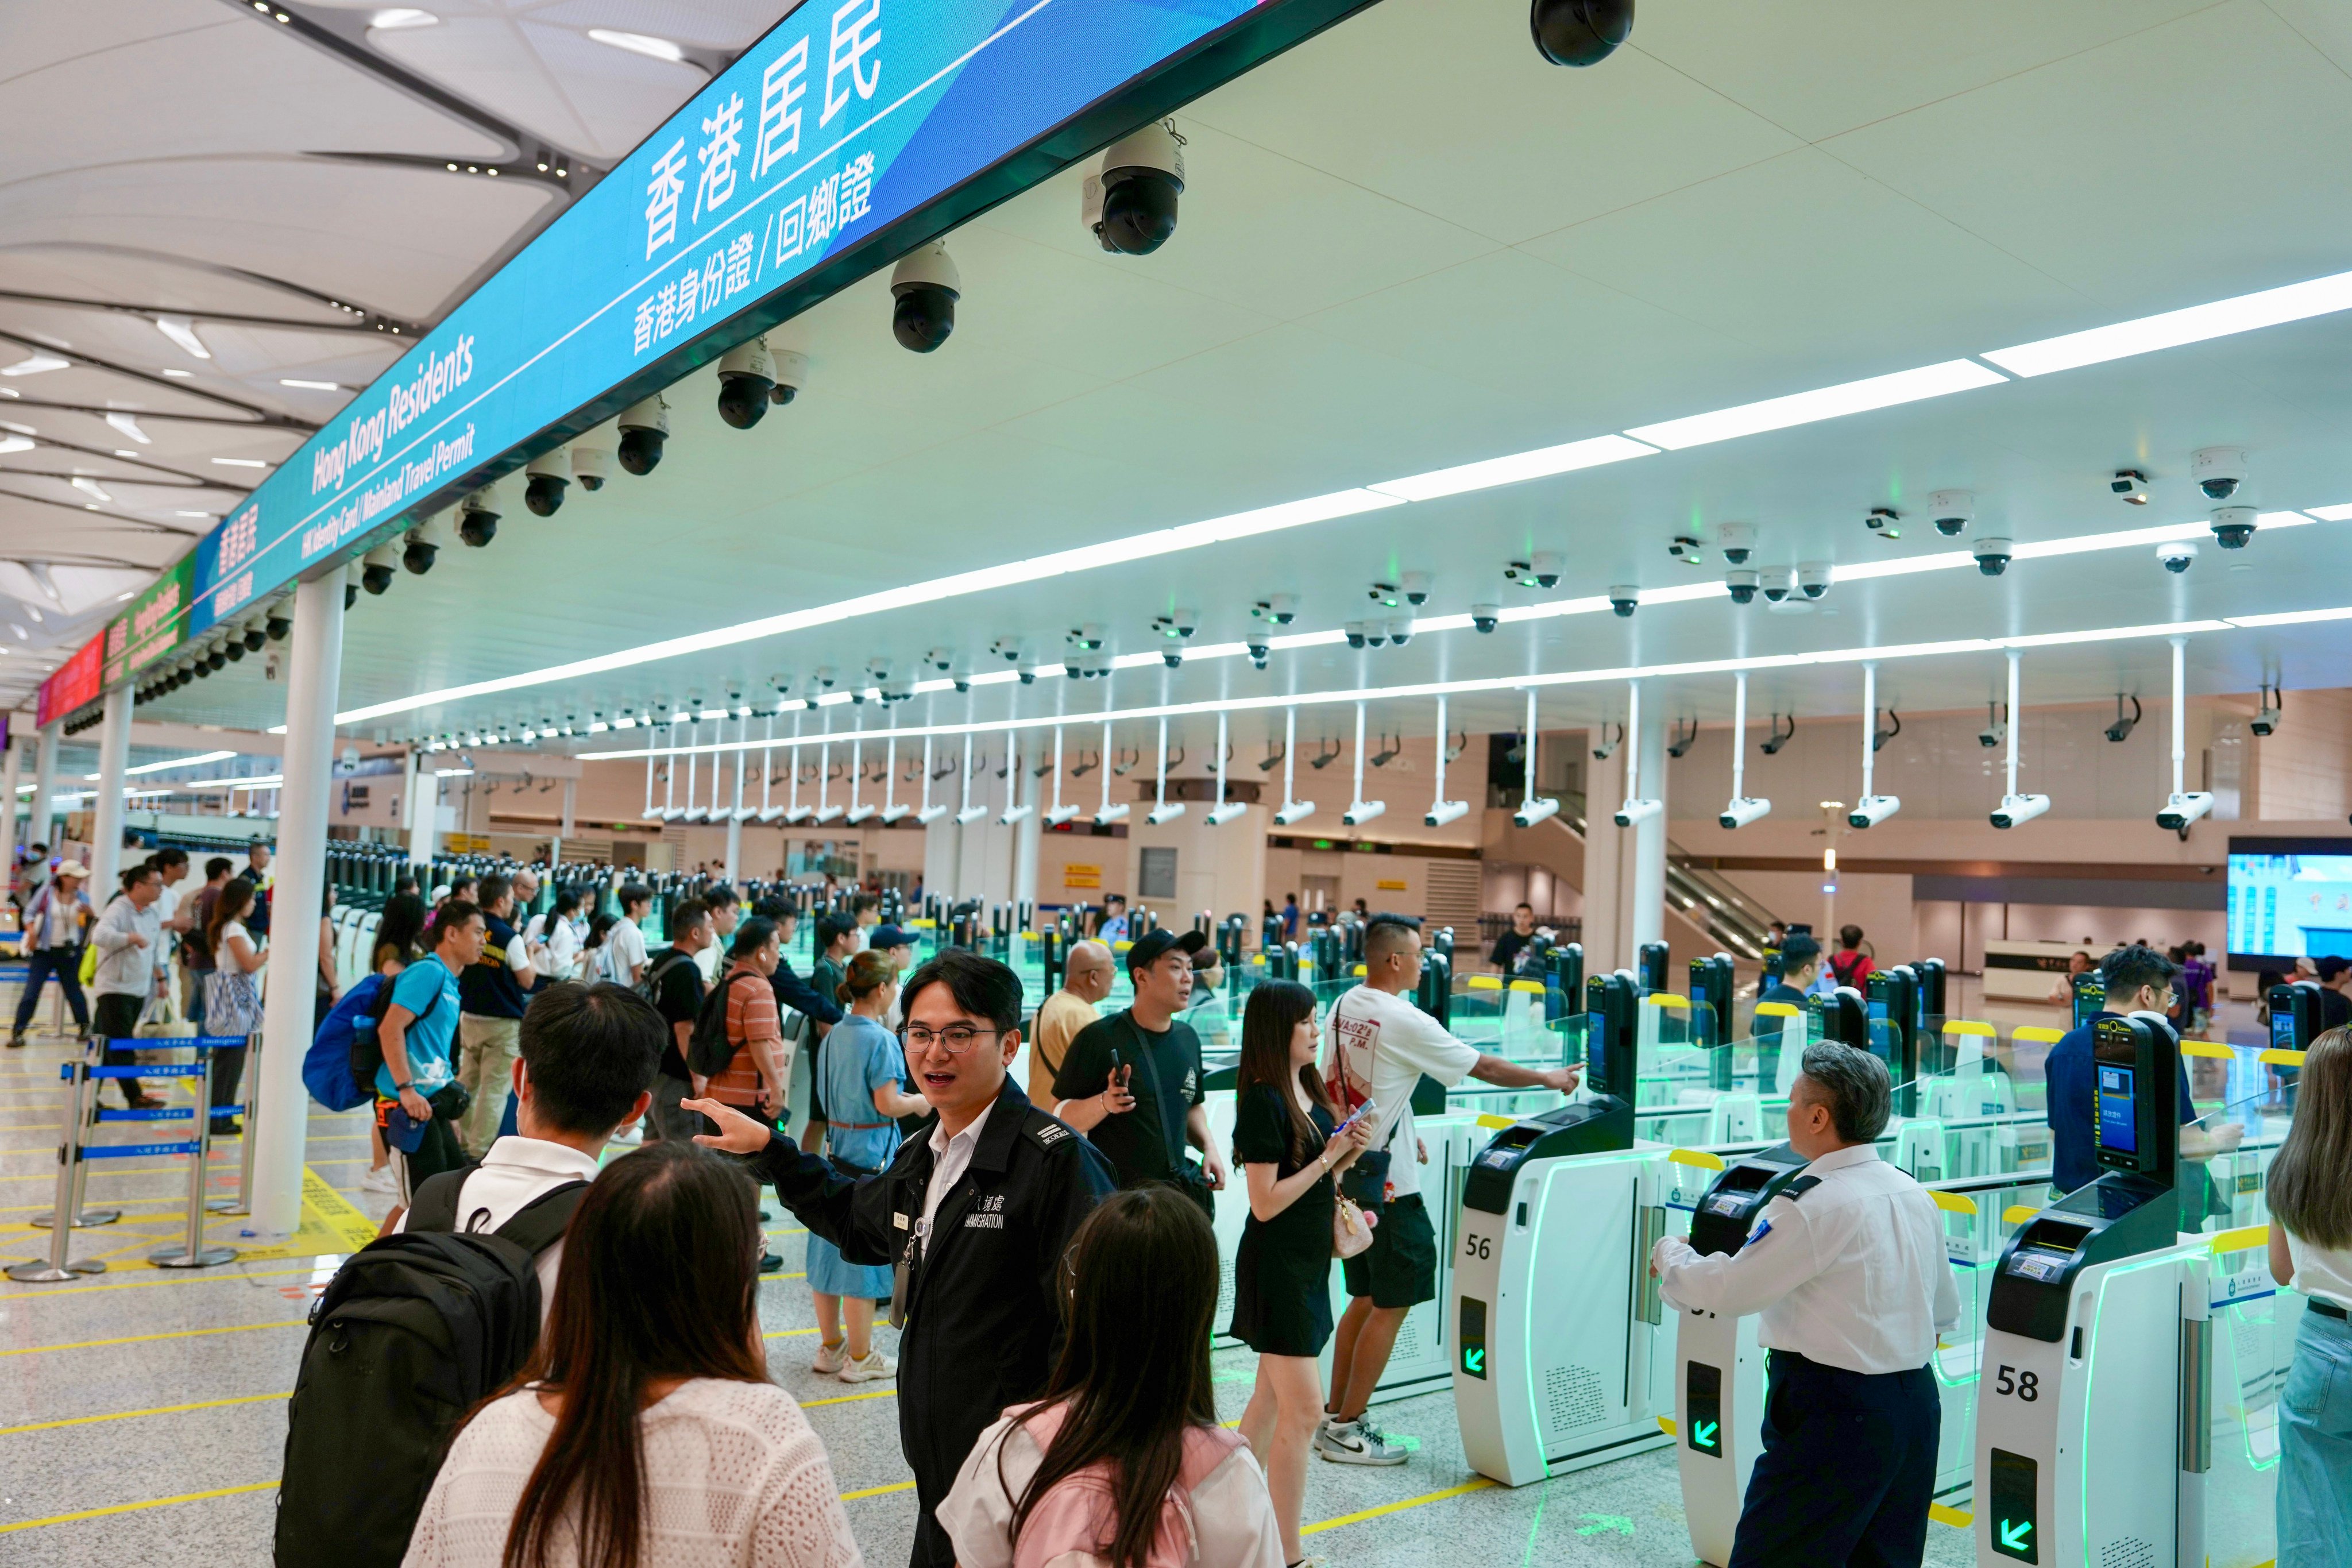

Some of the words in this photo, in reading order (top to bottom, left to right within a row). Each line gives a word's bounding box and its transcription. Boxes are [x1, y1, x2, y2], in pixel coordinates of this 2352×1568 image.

[644, 0, 882, 261] 香港居民
[312, 439, 347, 495] Hong
[347, 408, 385, 469] Kong
[387, 334, 474, 439] Residents
[302, 529, 314, 559] HK
[313, 515, 339, 549] Identity
[339, 497, 358, 536] Card
[362, 465, 404, 523] Mainland
[405, 444, 437, 496] Travel
[436, 423, 475, 477] Permit
[964, 1213, 1003, 1229] IMMIGRATION
[971, 1195, 1005, 1211] 入境處
[1465, 1233, 1492, 1261] 56
[1996, 1365, 2039, 1402] 58
